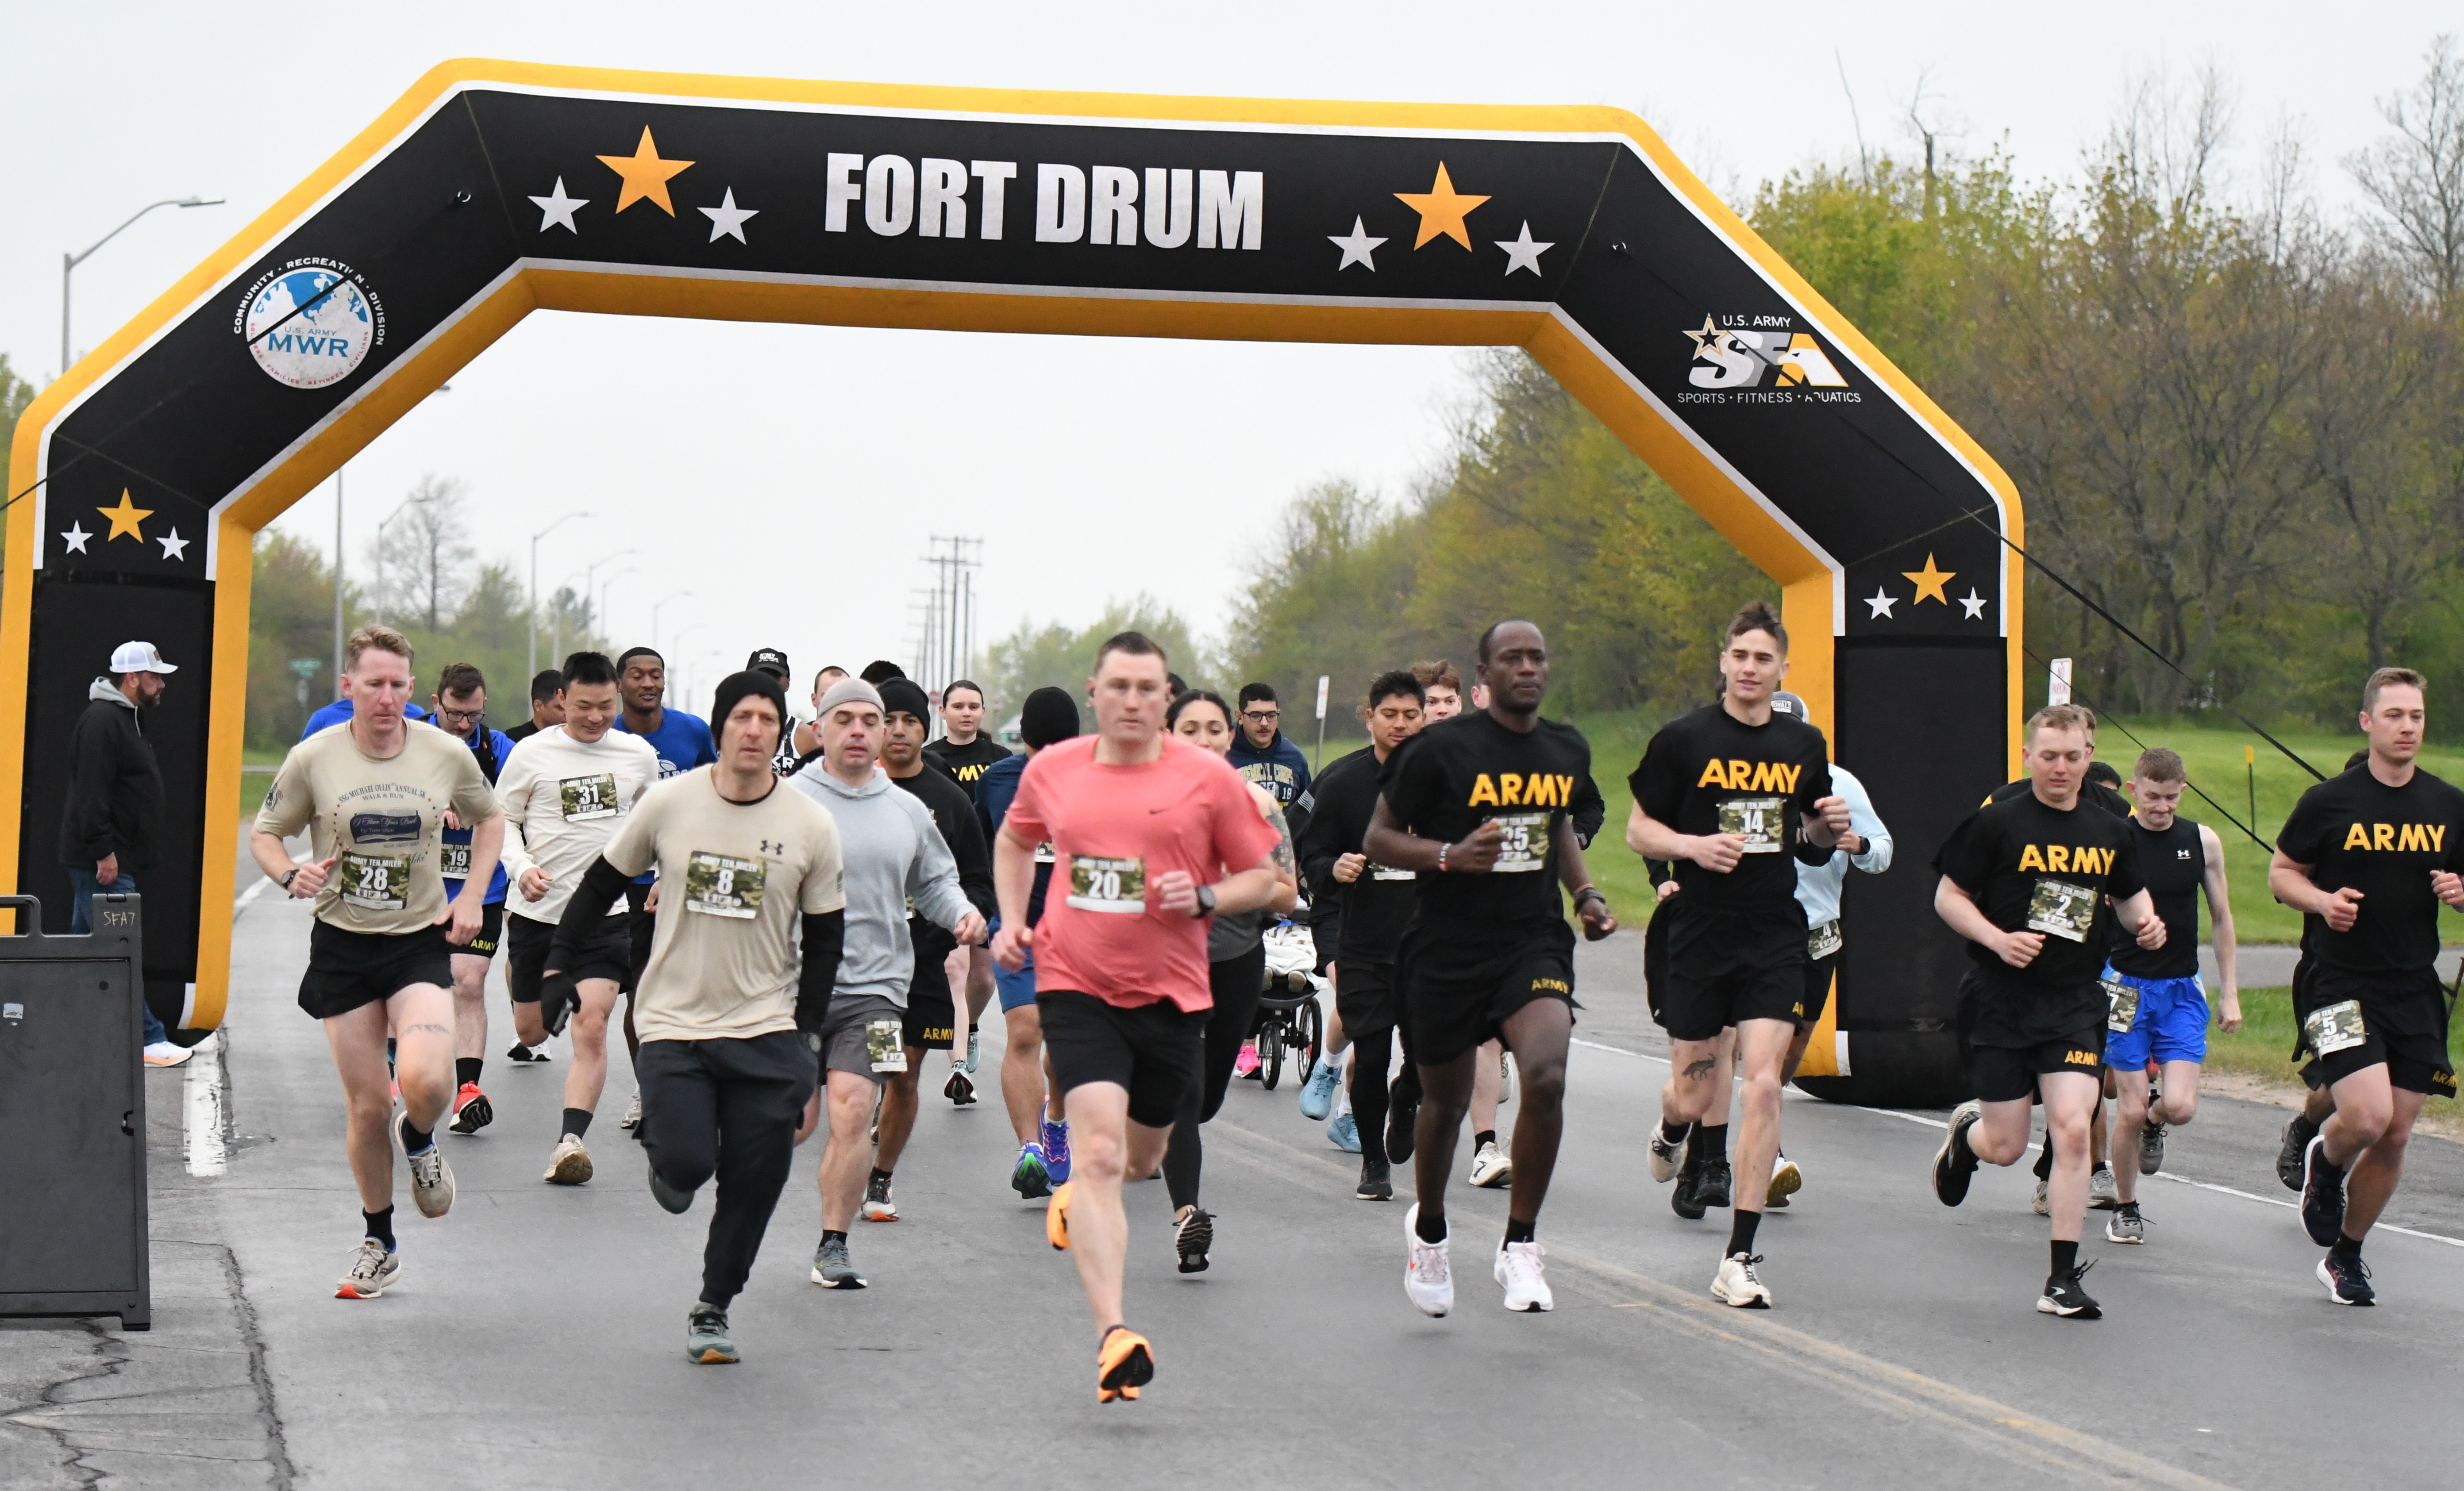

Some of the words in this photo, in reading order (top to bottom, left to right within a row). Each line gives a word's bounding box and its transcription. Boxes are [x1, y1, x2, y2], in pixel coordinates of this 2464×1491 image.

[825, 152, 1017, 241] FORT
[1036, 162, 1263, 250] DRUM
[234, 269, 274, 334] COMMUNITY
[286, 257, 365, 284] RECREATIN
[369, 292, 385, 346] DIVISION
[1723, 315, 1749, 327] U.S.
[1753, 315, 1791, 328] ARMY
[268, 333, 349, 357] MWR
[1689, 330, 1849, 388] SFA
[1678, 393, 1725, 404] SPORTS
[1737, 392, 1793, 403] FITNESS
[1697, 758, 1802, 793] ARMY
[339, 794, 350, 803] SSG
[349, 785, 373, 796] MICHAEL
[395, 785, 418, 795] ANNUAL
[418, 790, 427, 799] 5K
[579, 785, 599, 804] 31
[1282, 787, 1292, 800] 18
[1468, 773, 1574, 807] ARMY
[1741, 811, 1763, 833] 14
[1501, 827, 1528, 850] 25
[2343, 823, 2445, 852] ARMY
[350, 856, 368, 865] ARMY
[382, 860, 402, 868] MILER
[449, 851, 467, 866] 19
[2018, 844, 2115, 875] ARMY
[360, 867, 388, 891] 28
[717, 869, 734, 895] 8
[1088, 871, 1121, 900] 20
[2056, 895, 2071, 917] 2
[104, 911, 135, 926] SFA7
[1823, 922, 1832, 938] 4
[471, 939, 496, 951] ARMY
[1532, 978, 1569, 995] ARMY
[923, 1027, 954, 1040] ARMY
[2322, 1016, 2337, 1036] 5
[892, 1030, 901, 1051] 1
